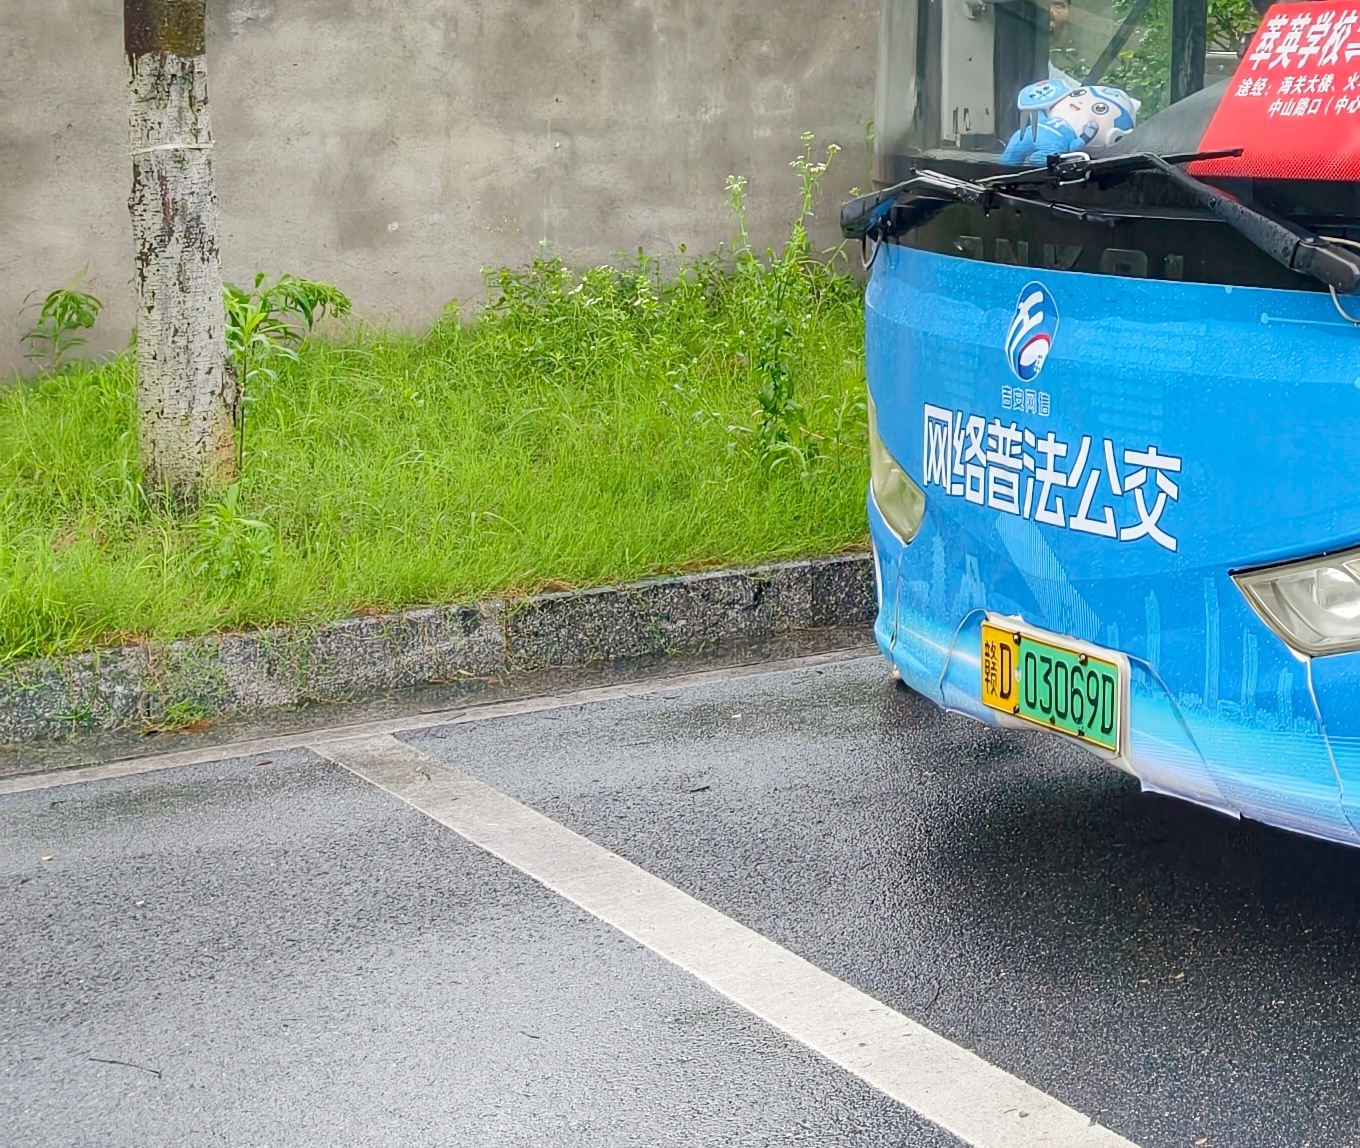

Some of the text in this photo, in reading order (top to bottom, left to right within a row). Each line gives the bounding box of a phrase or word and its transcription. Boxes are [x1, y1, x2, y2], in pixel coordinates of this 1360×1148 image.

[1001, 384, 1051, 417] 吉安网信
[923, 403, 1182, 553] 网络普法公交
